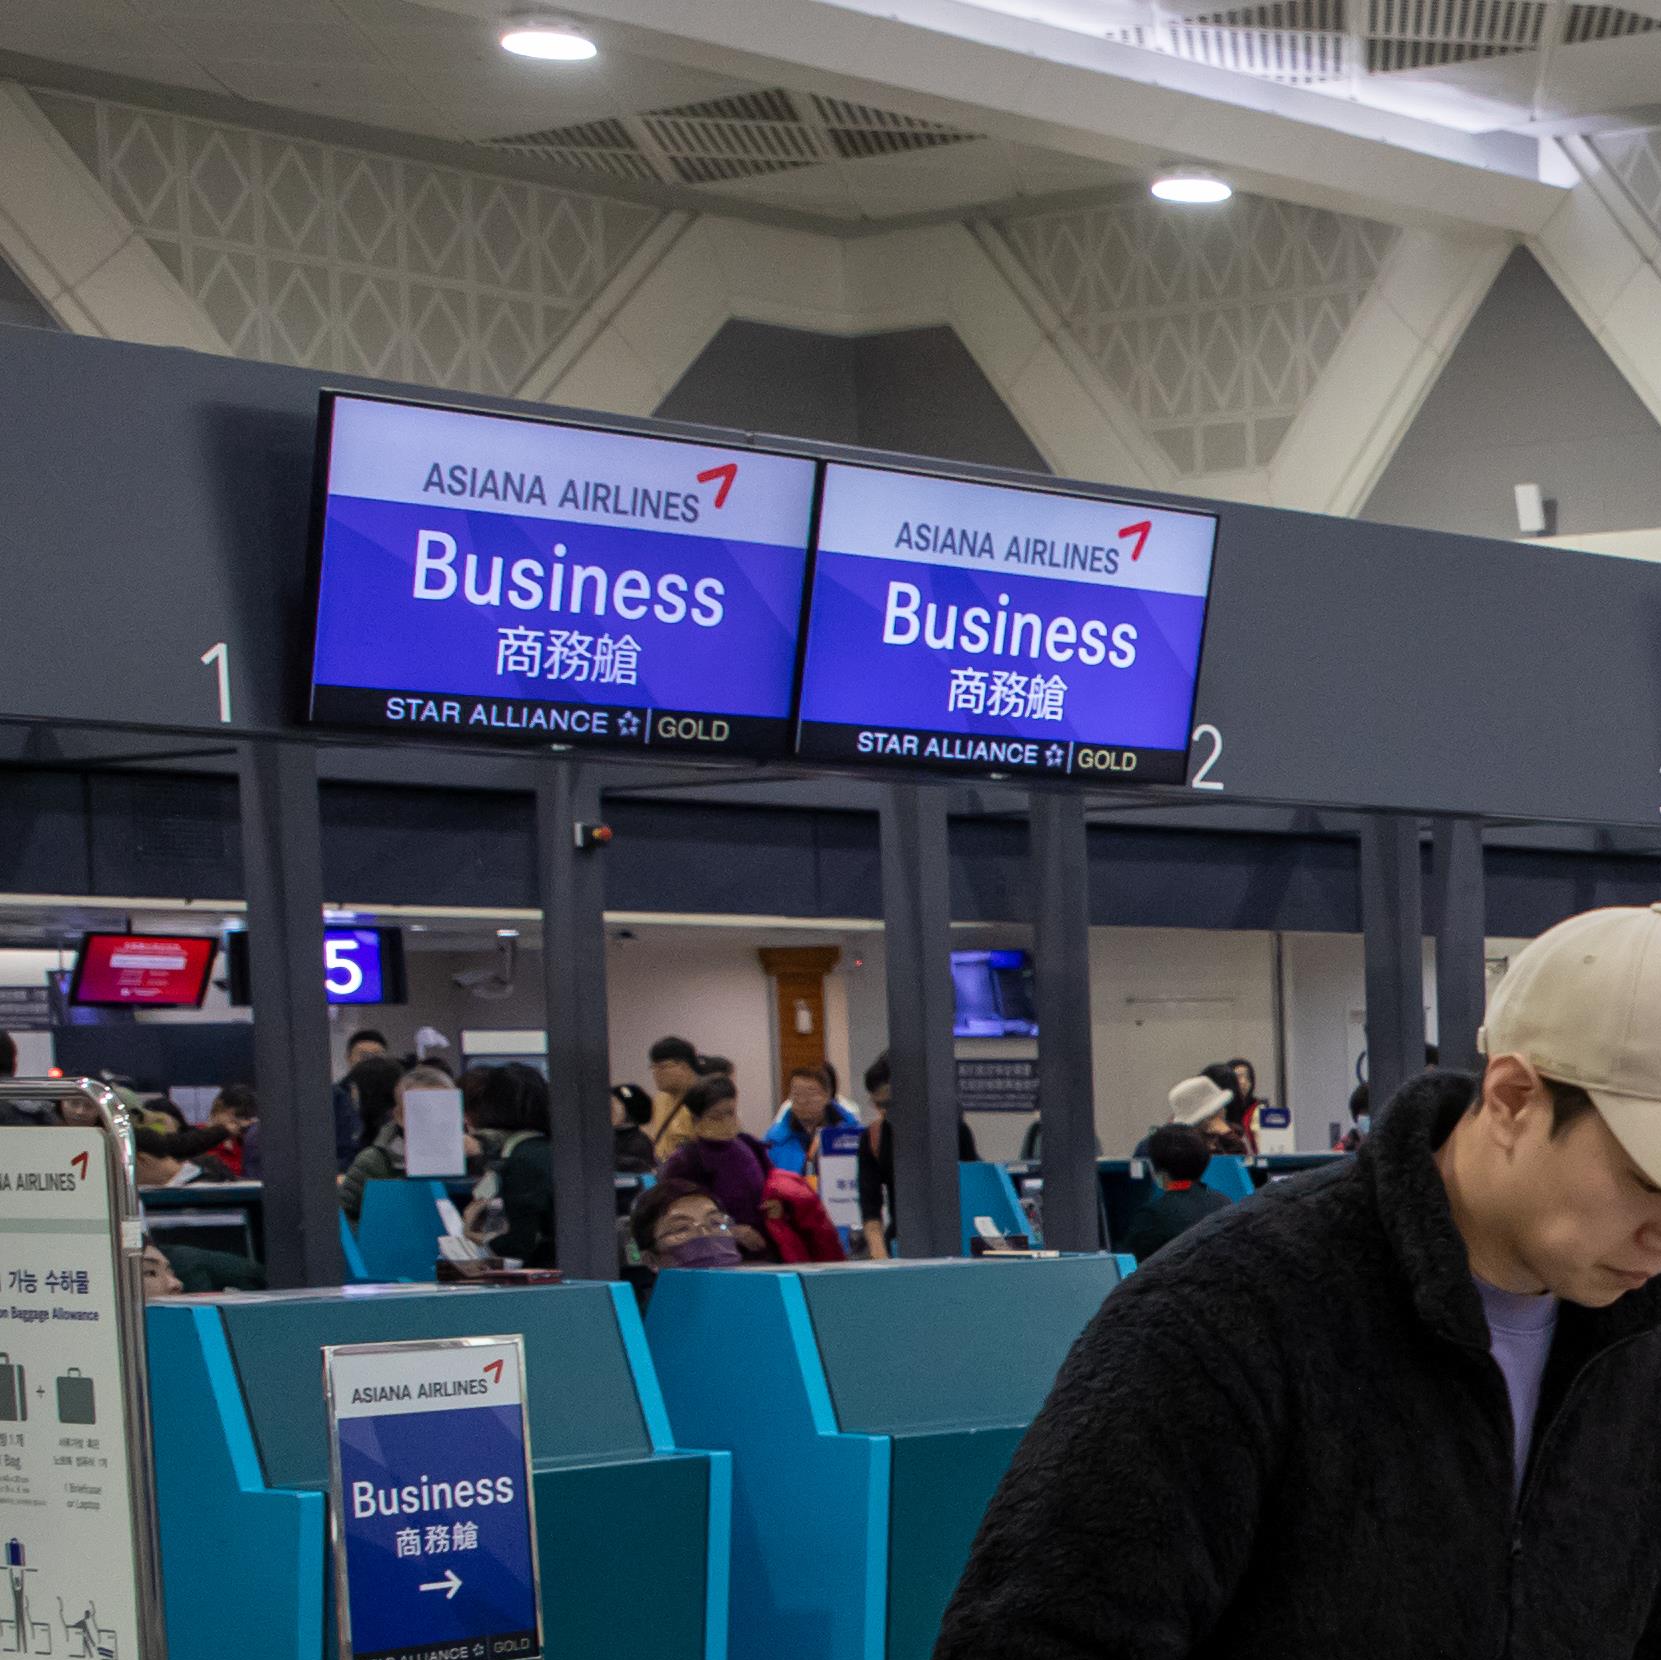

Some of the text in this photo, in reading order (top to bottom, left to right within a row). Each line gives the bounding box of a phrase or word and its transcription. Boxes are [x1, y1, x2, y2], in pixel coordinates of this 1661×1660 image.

[422, 461, 701, 524] ASIANA AIRLINES
[894, 521, 1120, 576] ASIANA AIRLINES
[412, 529, 727, 629] Business
[881, 580, 1139, 670] Business
[495, 626, 643, 687] 商務艙
[200, 642, 232, 723] 1
[946, 667, 1069, 723] 商務艙
[385, 696, 731, 744] STAR ALLIANCE GOLD
[856, 731, 1138, 774] STAR ALLIANCE GOLD
[1191, 722, 1225, 791] 2
[16, 1172, 76, 1192] AIRLINES
[8, 1268, 90, 1295] 가능 수하물
[52, 1307, 99, 1321] Allowance
[351, 1378, 488, 1404] ASIANA AIRLINES
[351, 1474, 515, 1519] Business
[396, 1520, 480, 1559] 商務艙
[492, 1637, 532, 1654] GOLD
